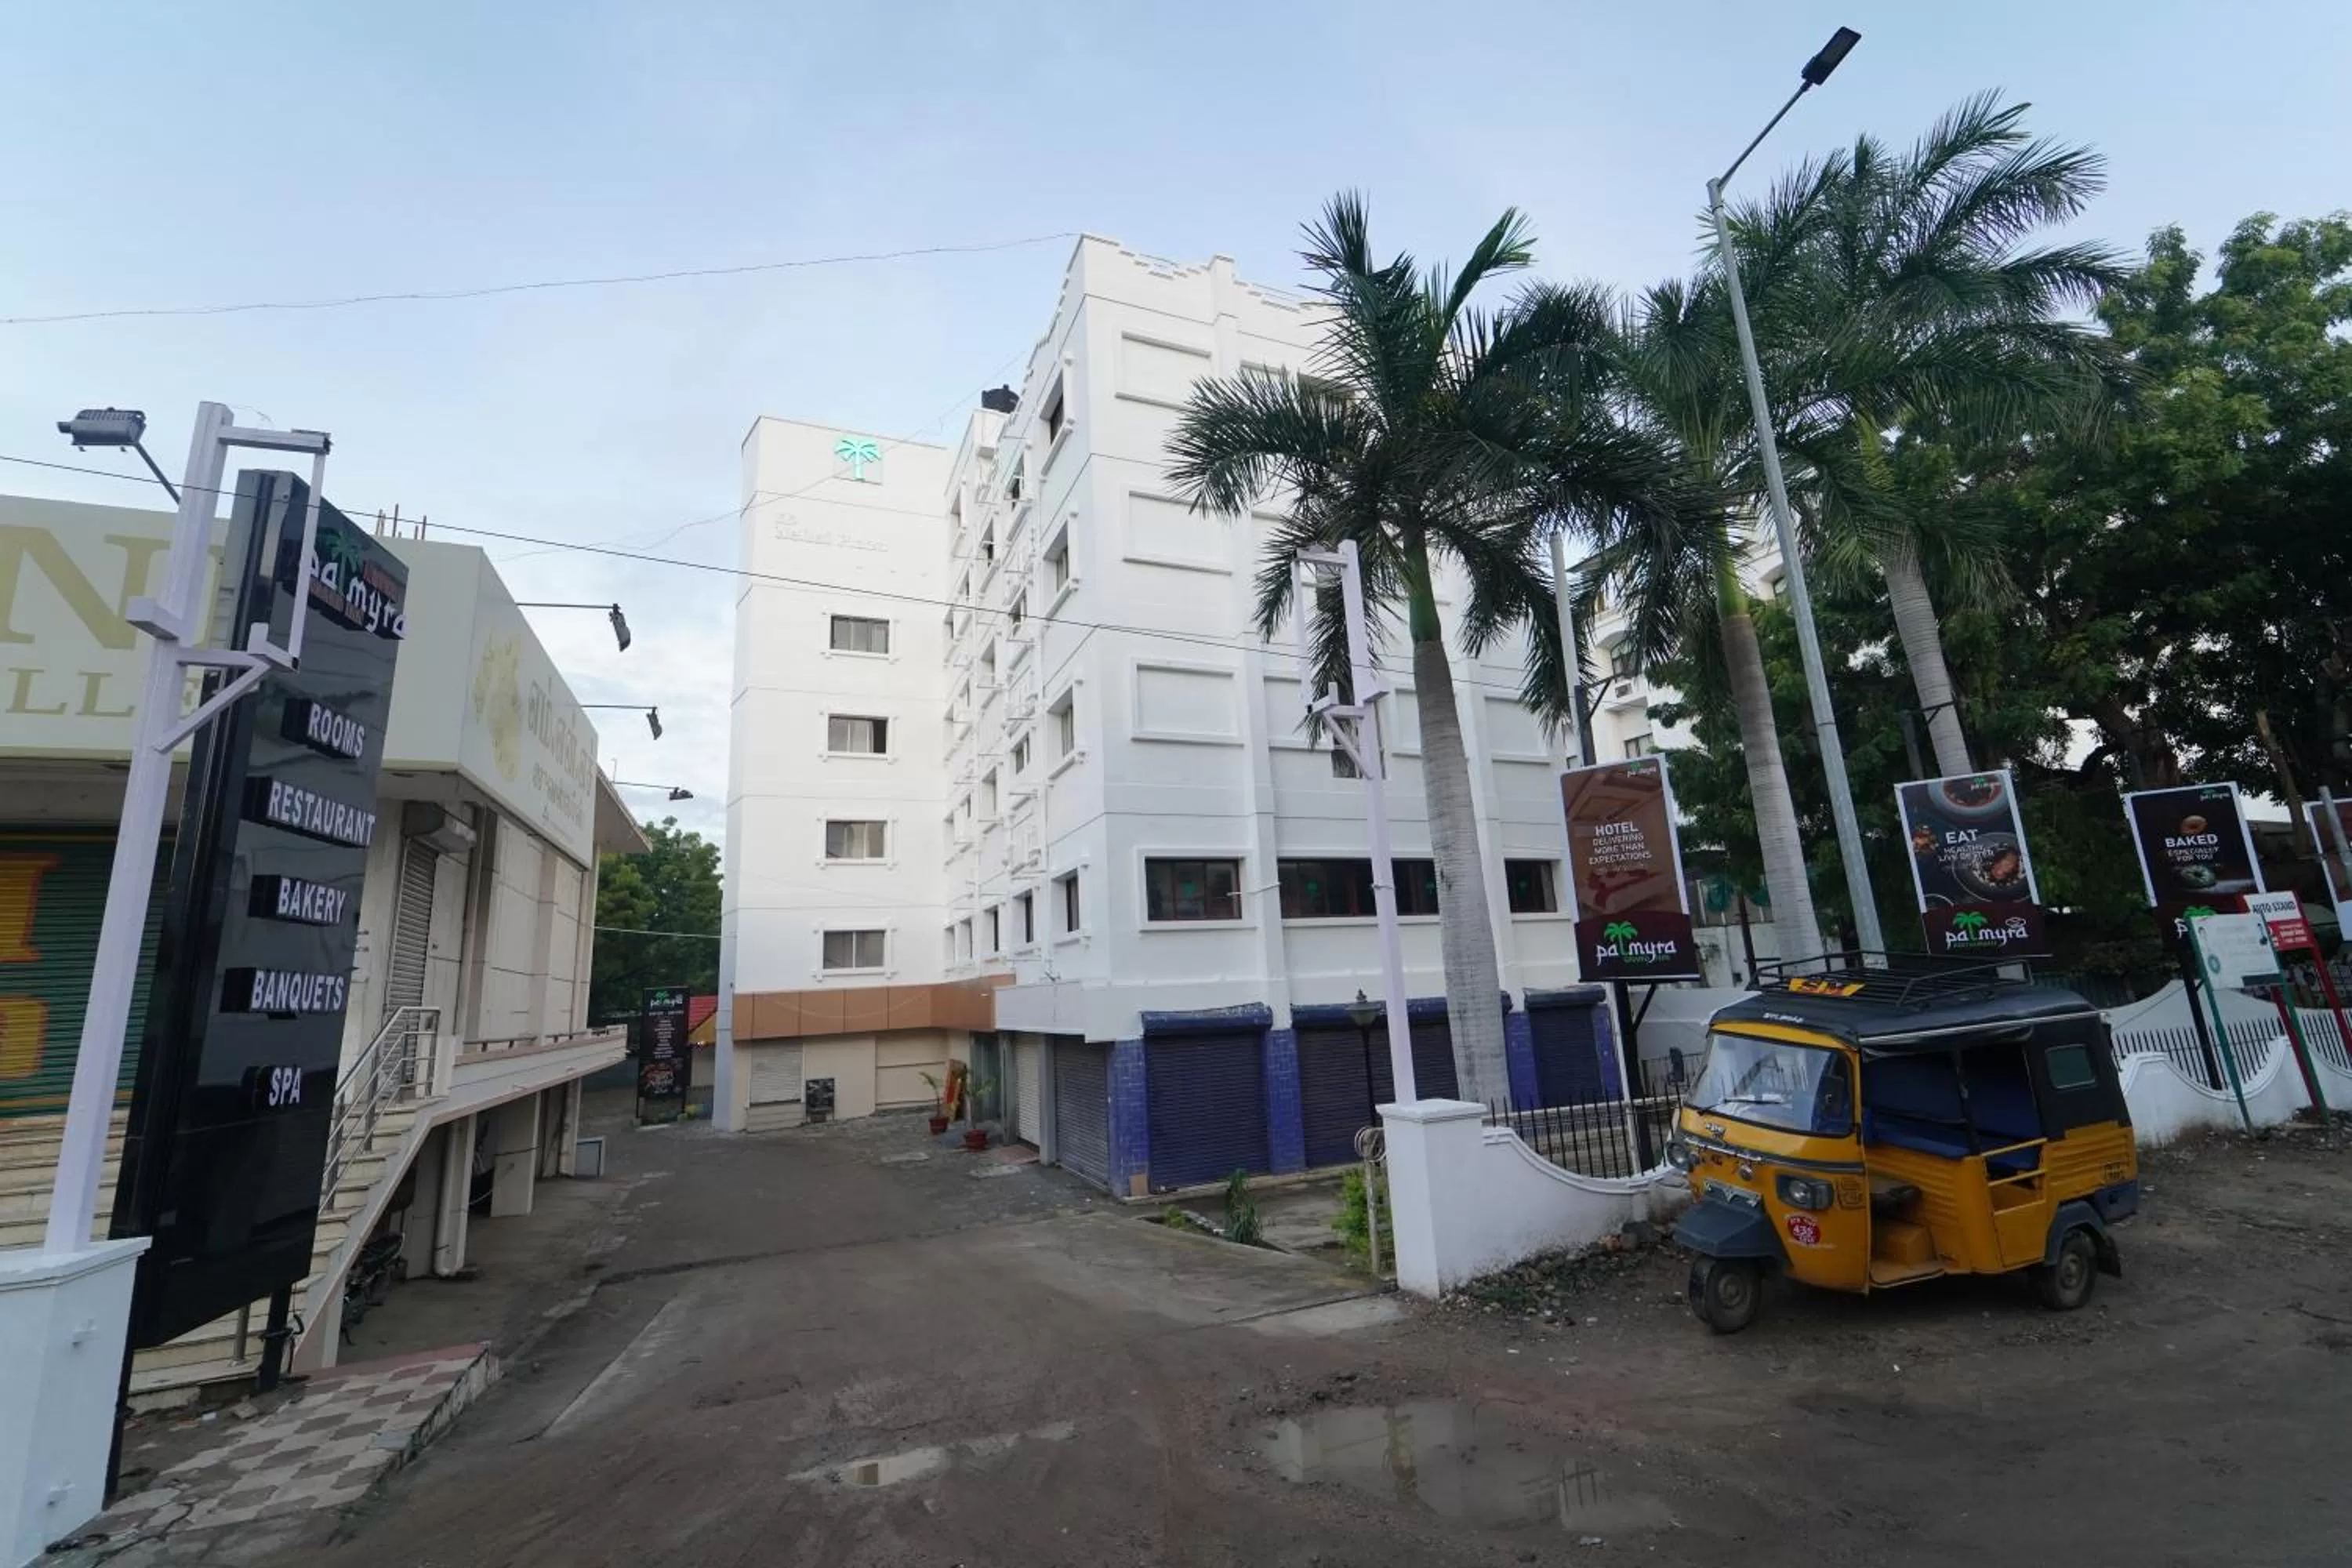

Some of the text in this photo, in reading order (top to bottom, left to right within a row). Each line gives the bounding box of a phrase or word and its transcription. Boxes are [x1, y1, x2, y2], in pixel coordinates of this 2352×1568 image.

[308, 702, 365, 757] ROOMS
[269, 781, 376, 847] RESTAURANT
[1595, 821, 1639, 837] HOTEL
[1621, 842, 1645, 852] THAN
[1945, 829, 1978, 844] EAT
[2165, 833, 2218, 848] BAKED
[277, 878, 347, 924] BAKERY
[1596, 933, 1677, 966] palmyra
[1945, 921, 2028, 949] palmyra
[251, 970, 344, 1011] BANQUETS
[269, 1067, 301, 1106] SPA
